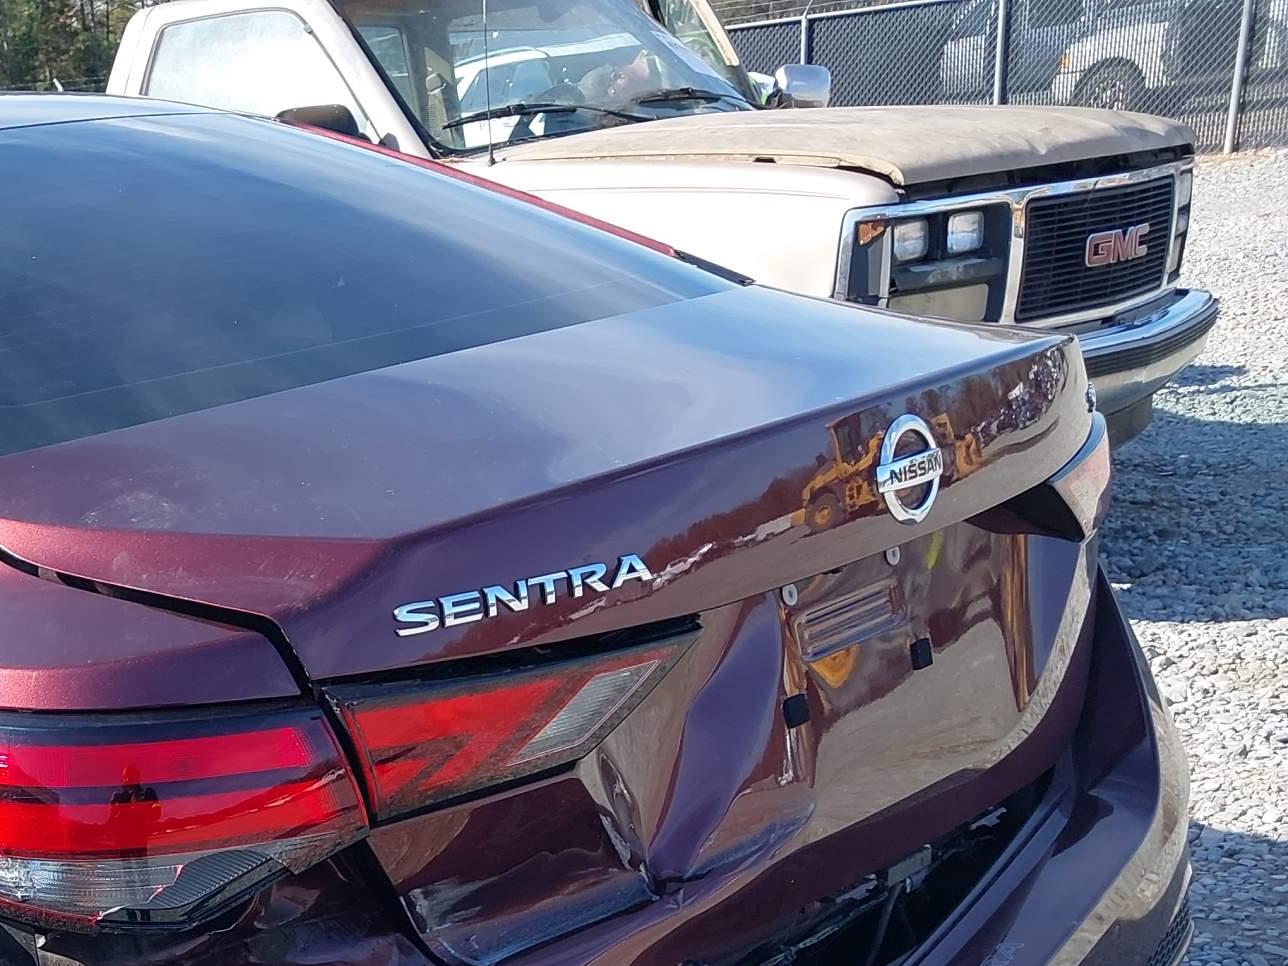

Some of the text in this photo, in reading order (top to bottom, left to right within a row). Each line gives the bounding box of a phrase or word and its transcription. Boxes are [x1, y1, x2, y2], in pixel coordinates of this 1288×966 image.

[1085, 222, 1150, 268] GMC
[890, 449, 941, 485] NISSAN
[393, 553, 654, 637] SENTRA
